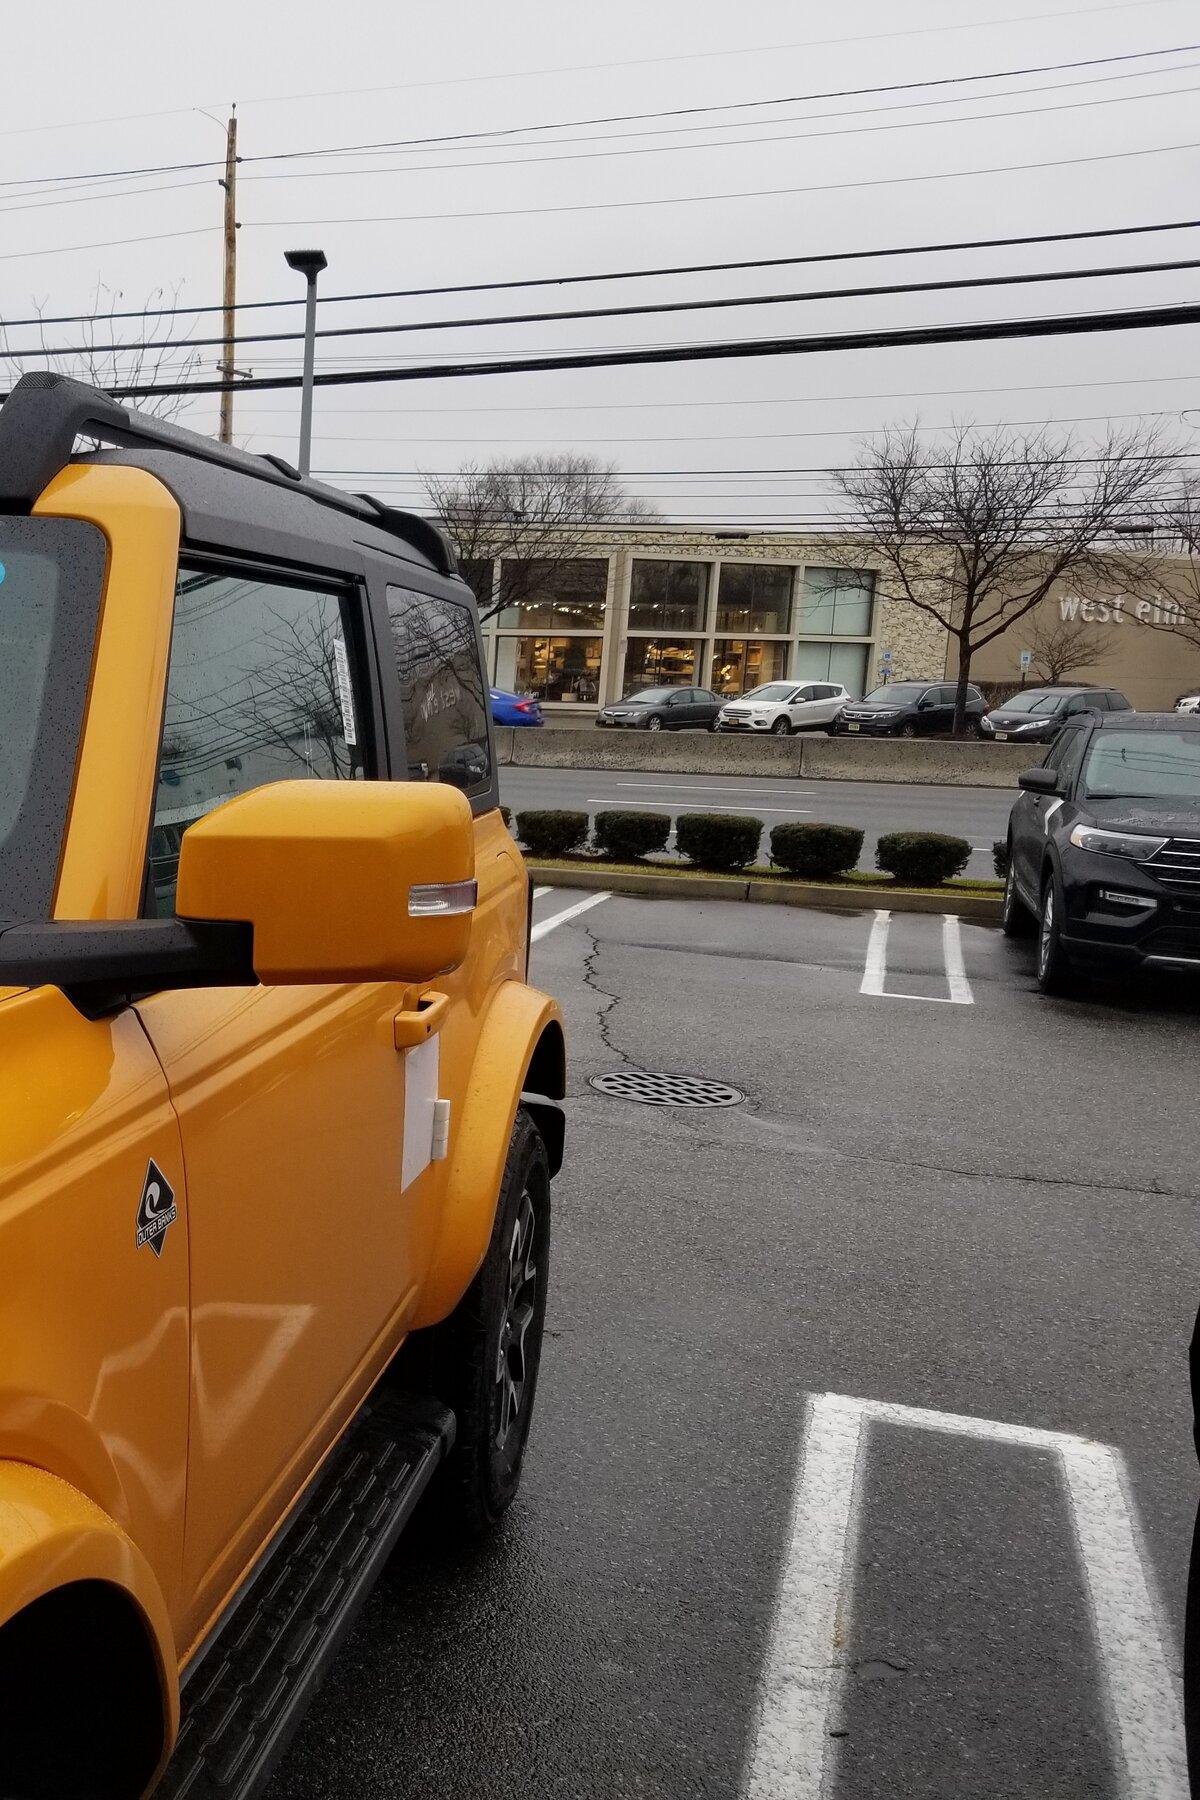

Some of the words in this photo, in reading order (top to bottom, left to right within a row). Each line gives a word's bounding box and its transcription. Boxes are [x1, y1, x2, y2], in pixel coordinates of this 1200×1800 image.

[1058, 594, 1125, 623] west
[1135, 594, 1187, 624] elm
[138, 1221, 158, 1245] OUTER
[157, 1207, 176, 1231] BANKS
